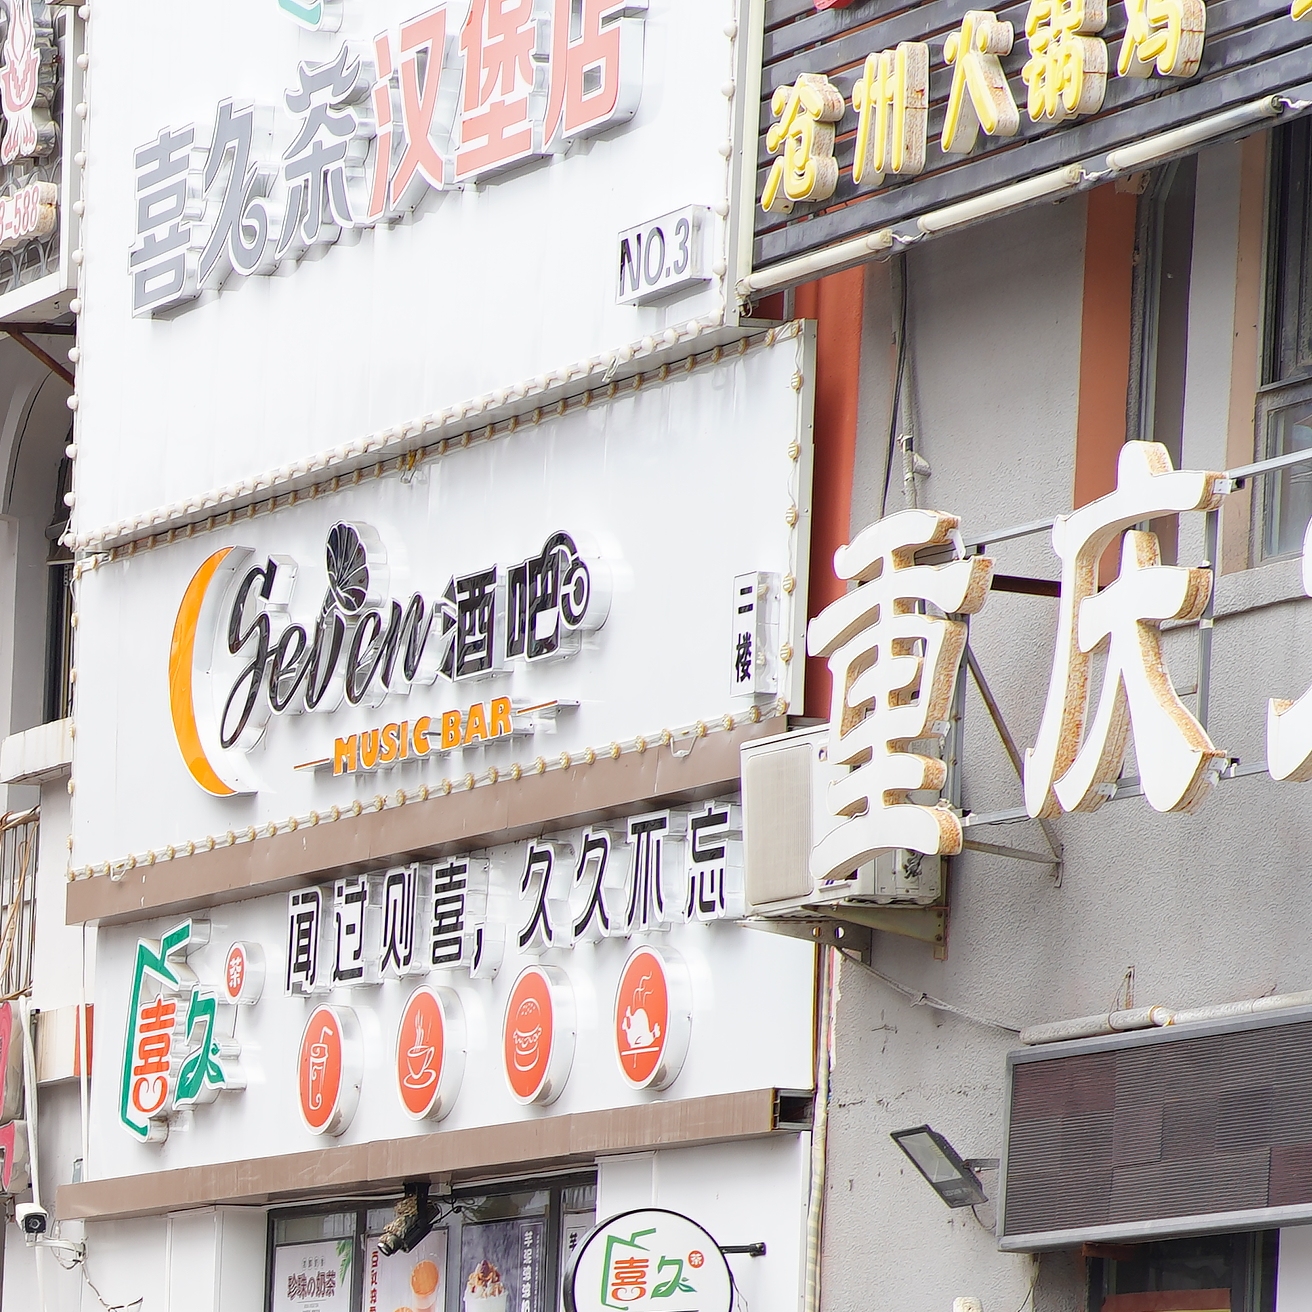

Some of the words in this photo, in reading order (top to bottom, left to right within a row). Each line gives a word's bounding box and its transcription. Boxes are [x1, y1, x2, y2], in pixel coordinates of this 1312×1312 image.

[619, 217, 691, 296] NO.3
[438, 532, 590, 682] 酒吧
[736, 585, 755, 684] 二楼
[333, 712, 433, 776] MUSIC
[440, 696, 515, 750] BAR
[516, 802, 733, 953] 久久不忘
[228, 953, 244, 988] 茶
